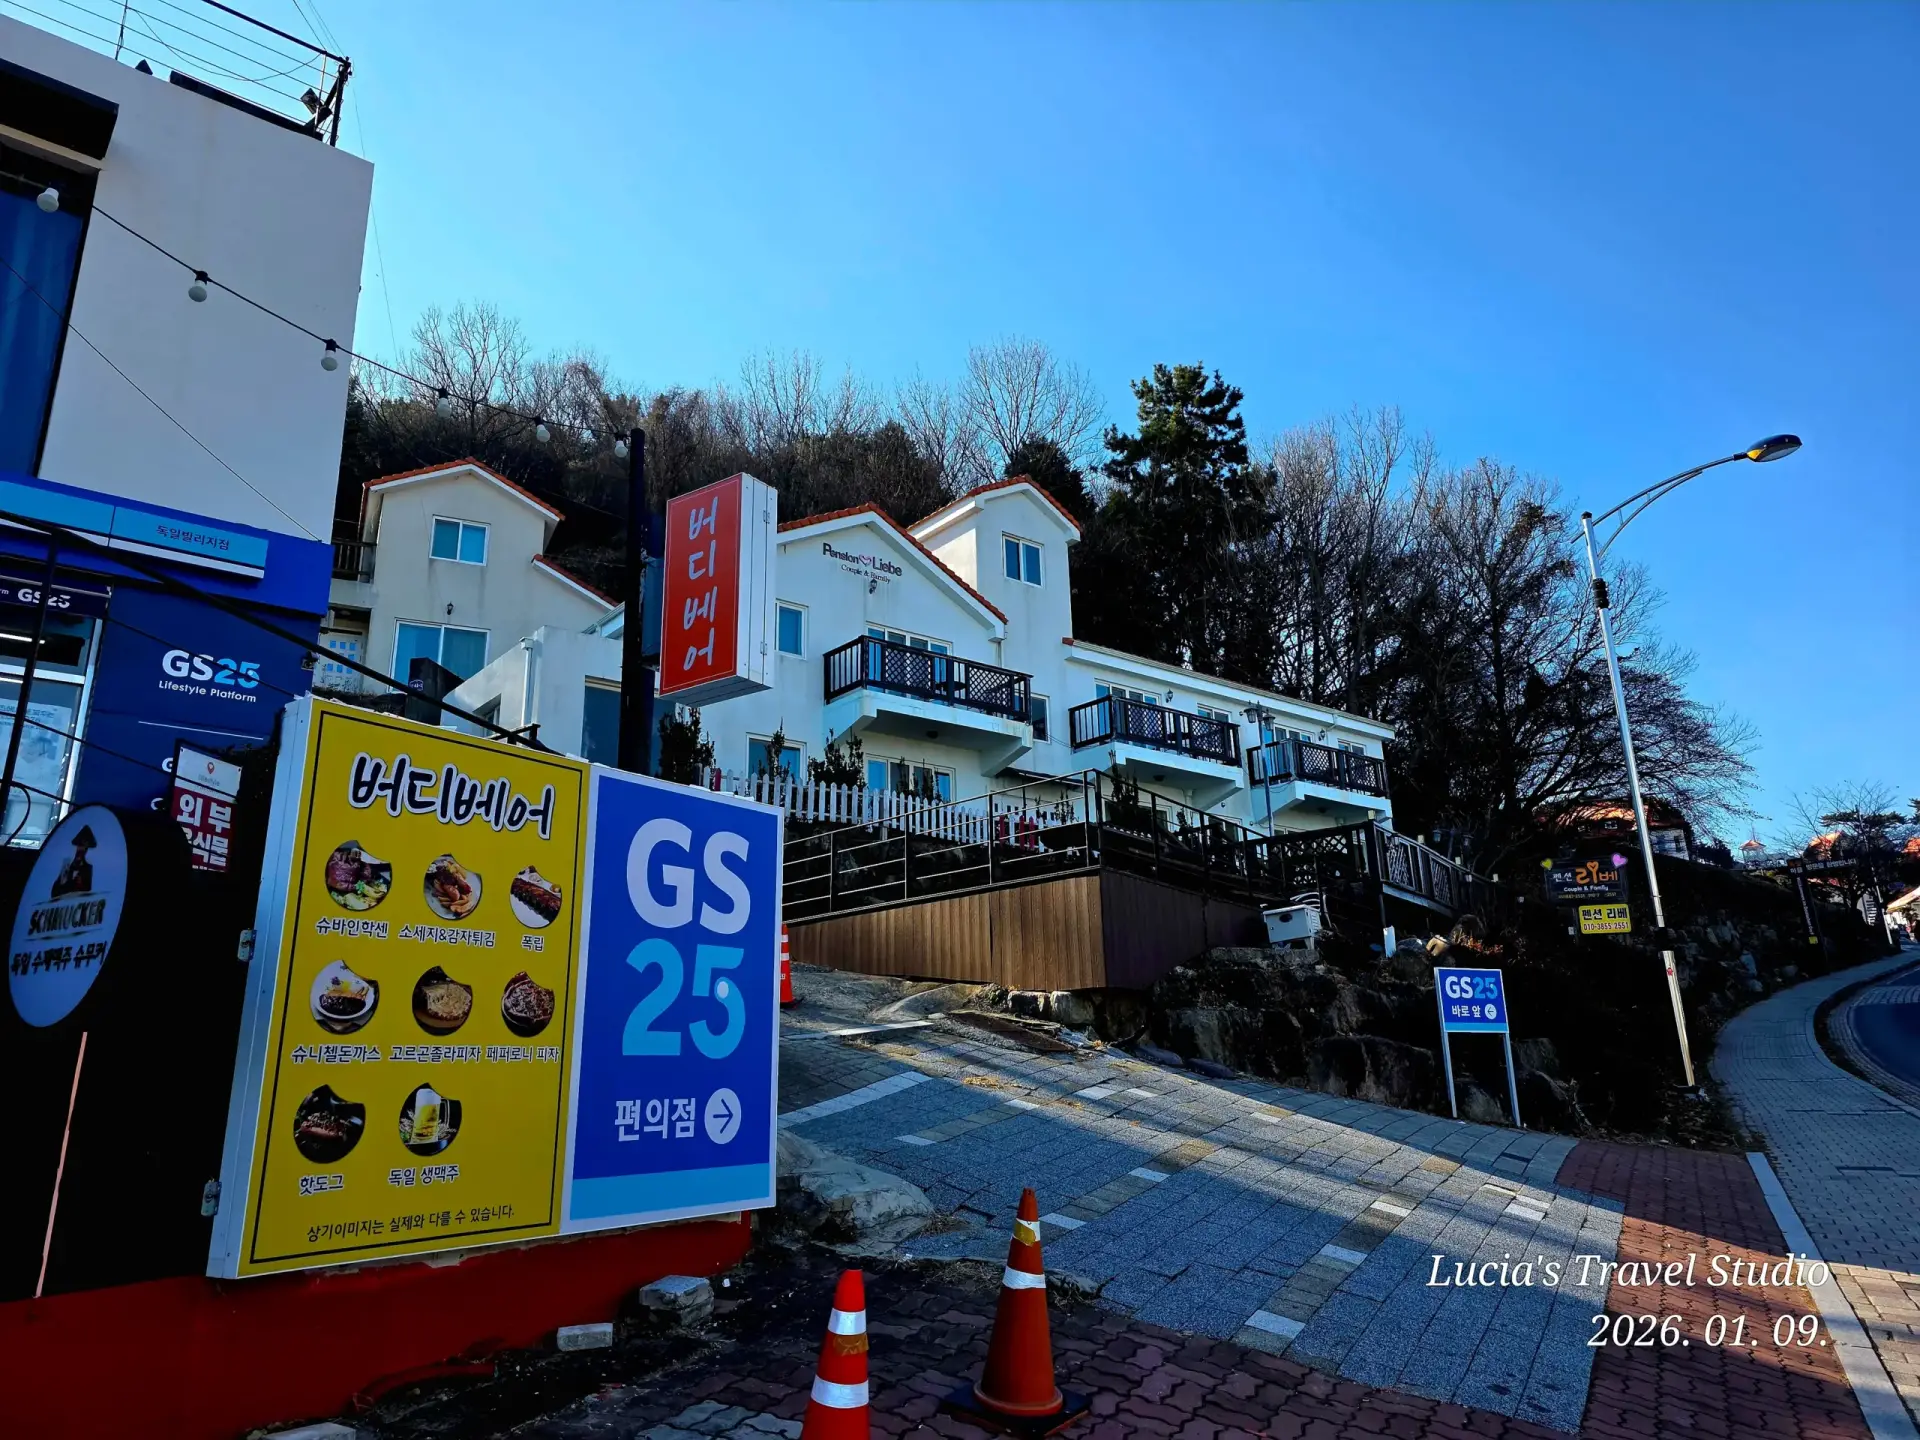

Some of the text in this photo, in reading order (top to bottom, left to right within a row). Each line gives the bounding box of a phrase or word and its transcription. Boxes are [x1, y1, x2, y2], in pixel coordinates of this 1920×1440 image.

[156, 525, 229, 551] 독일빌리지점
[823, 542, 902, 576] Pension Liebe
[683, 496, 718, 671] 버디베어
[162, 649, 260, 688] GS25
[159, 680, 257, 702] Lifestyle Platform
[348, 752, 556, 840] 버디베어
[626, 818, 751, 934] GS
[1552, 872, 1572, 882] 펜션
[1582, 907, 1627, 920] 펜션 리베
[316, 917, 388, 938] 슈바인학센
[399, 924, 496, 948] 소세지&감자튀김
[521, 934, 544, 952] 폭립
[622, 938, 747, 1059] 25
[1445, 975, 1498, 999] GS25
[1451, 1004, 1481, 1018] 바로 앞
[291, 1045, 381, 1064] 슈니첼돈까스
[388, 1045, 481, 1063] 고르곤졸라피자
[485, 1045, 560, 1063] 페퍼로니 피자
[614, 1097, 697, 1142] 편의점
[299, 1174, 344, 1196] 핫도그
[388, 1164, 459, 1187] 독일 생맥주
[307, 1204, 515, 1243] 상기이미지는 실제와 다를 수 있습니다.
